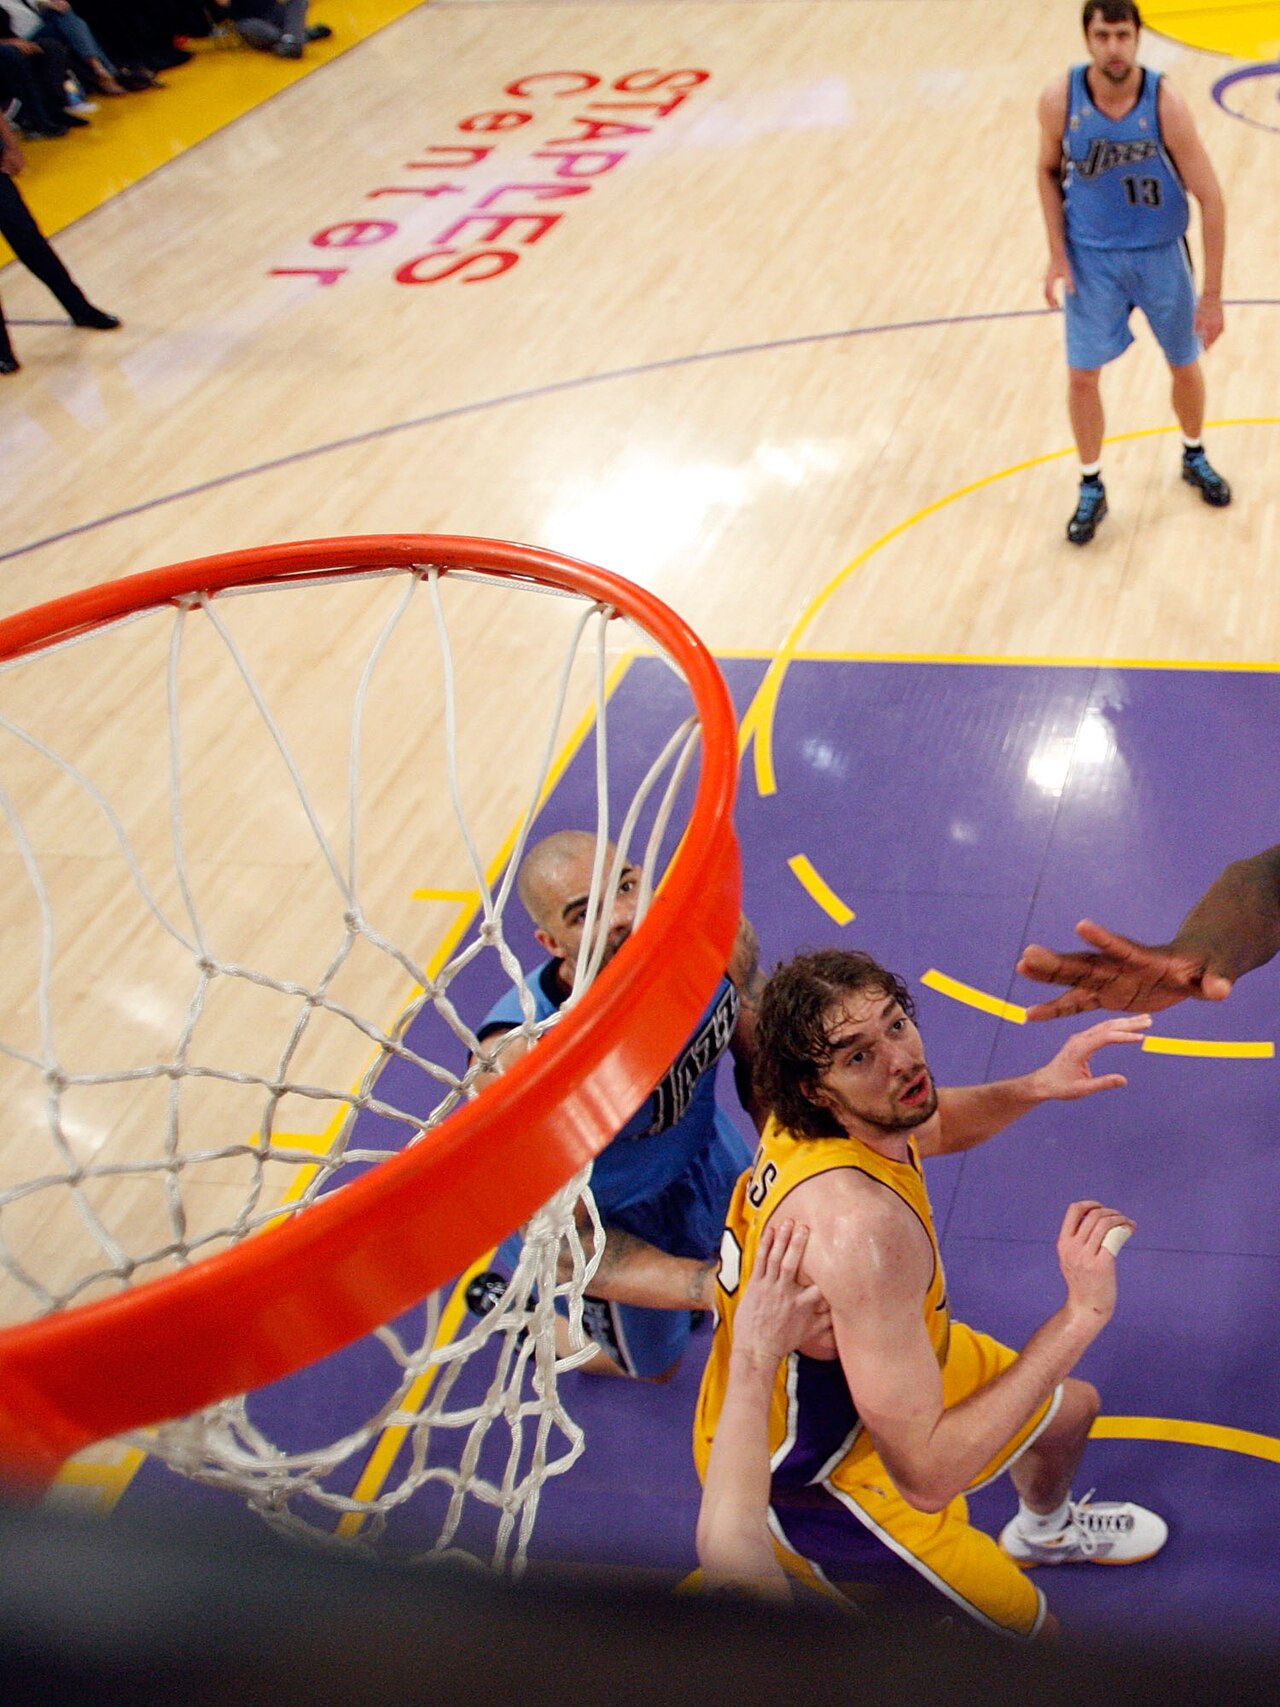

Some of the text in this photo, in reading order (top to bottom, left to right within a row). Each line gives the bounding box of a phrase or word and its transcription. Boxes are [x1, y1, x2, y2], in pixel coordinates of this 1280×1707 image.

[266, 69, 602, 287] Center
[392, 67, 711, 287] STAPLES
[1120, 175, 1163, 208] 13
